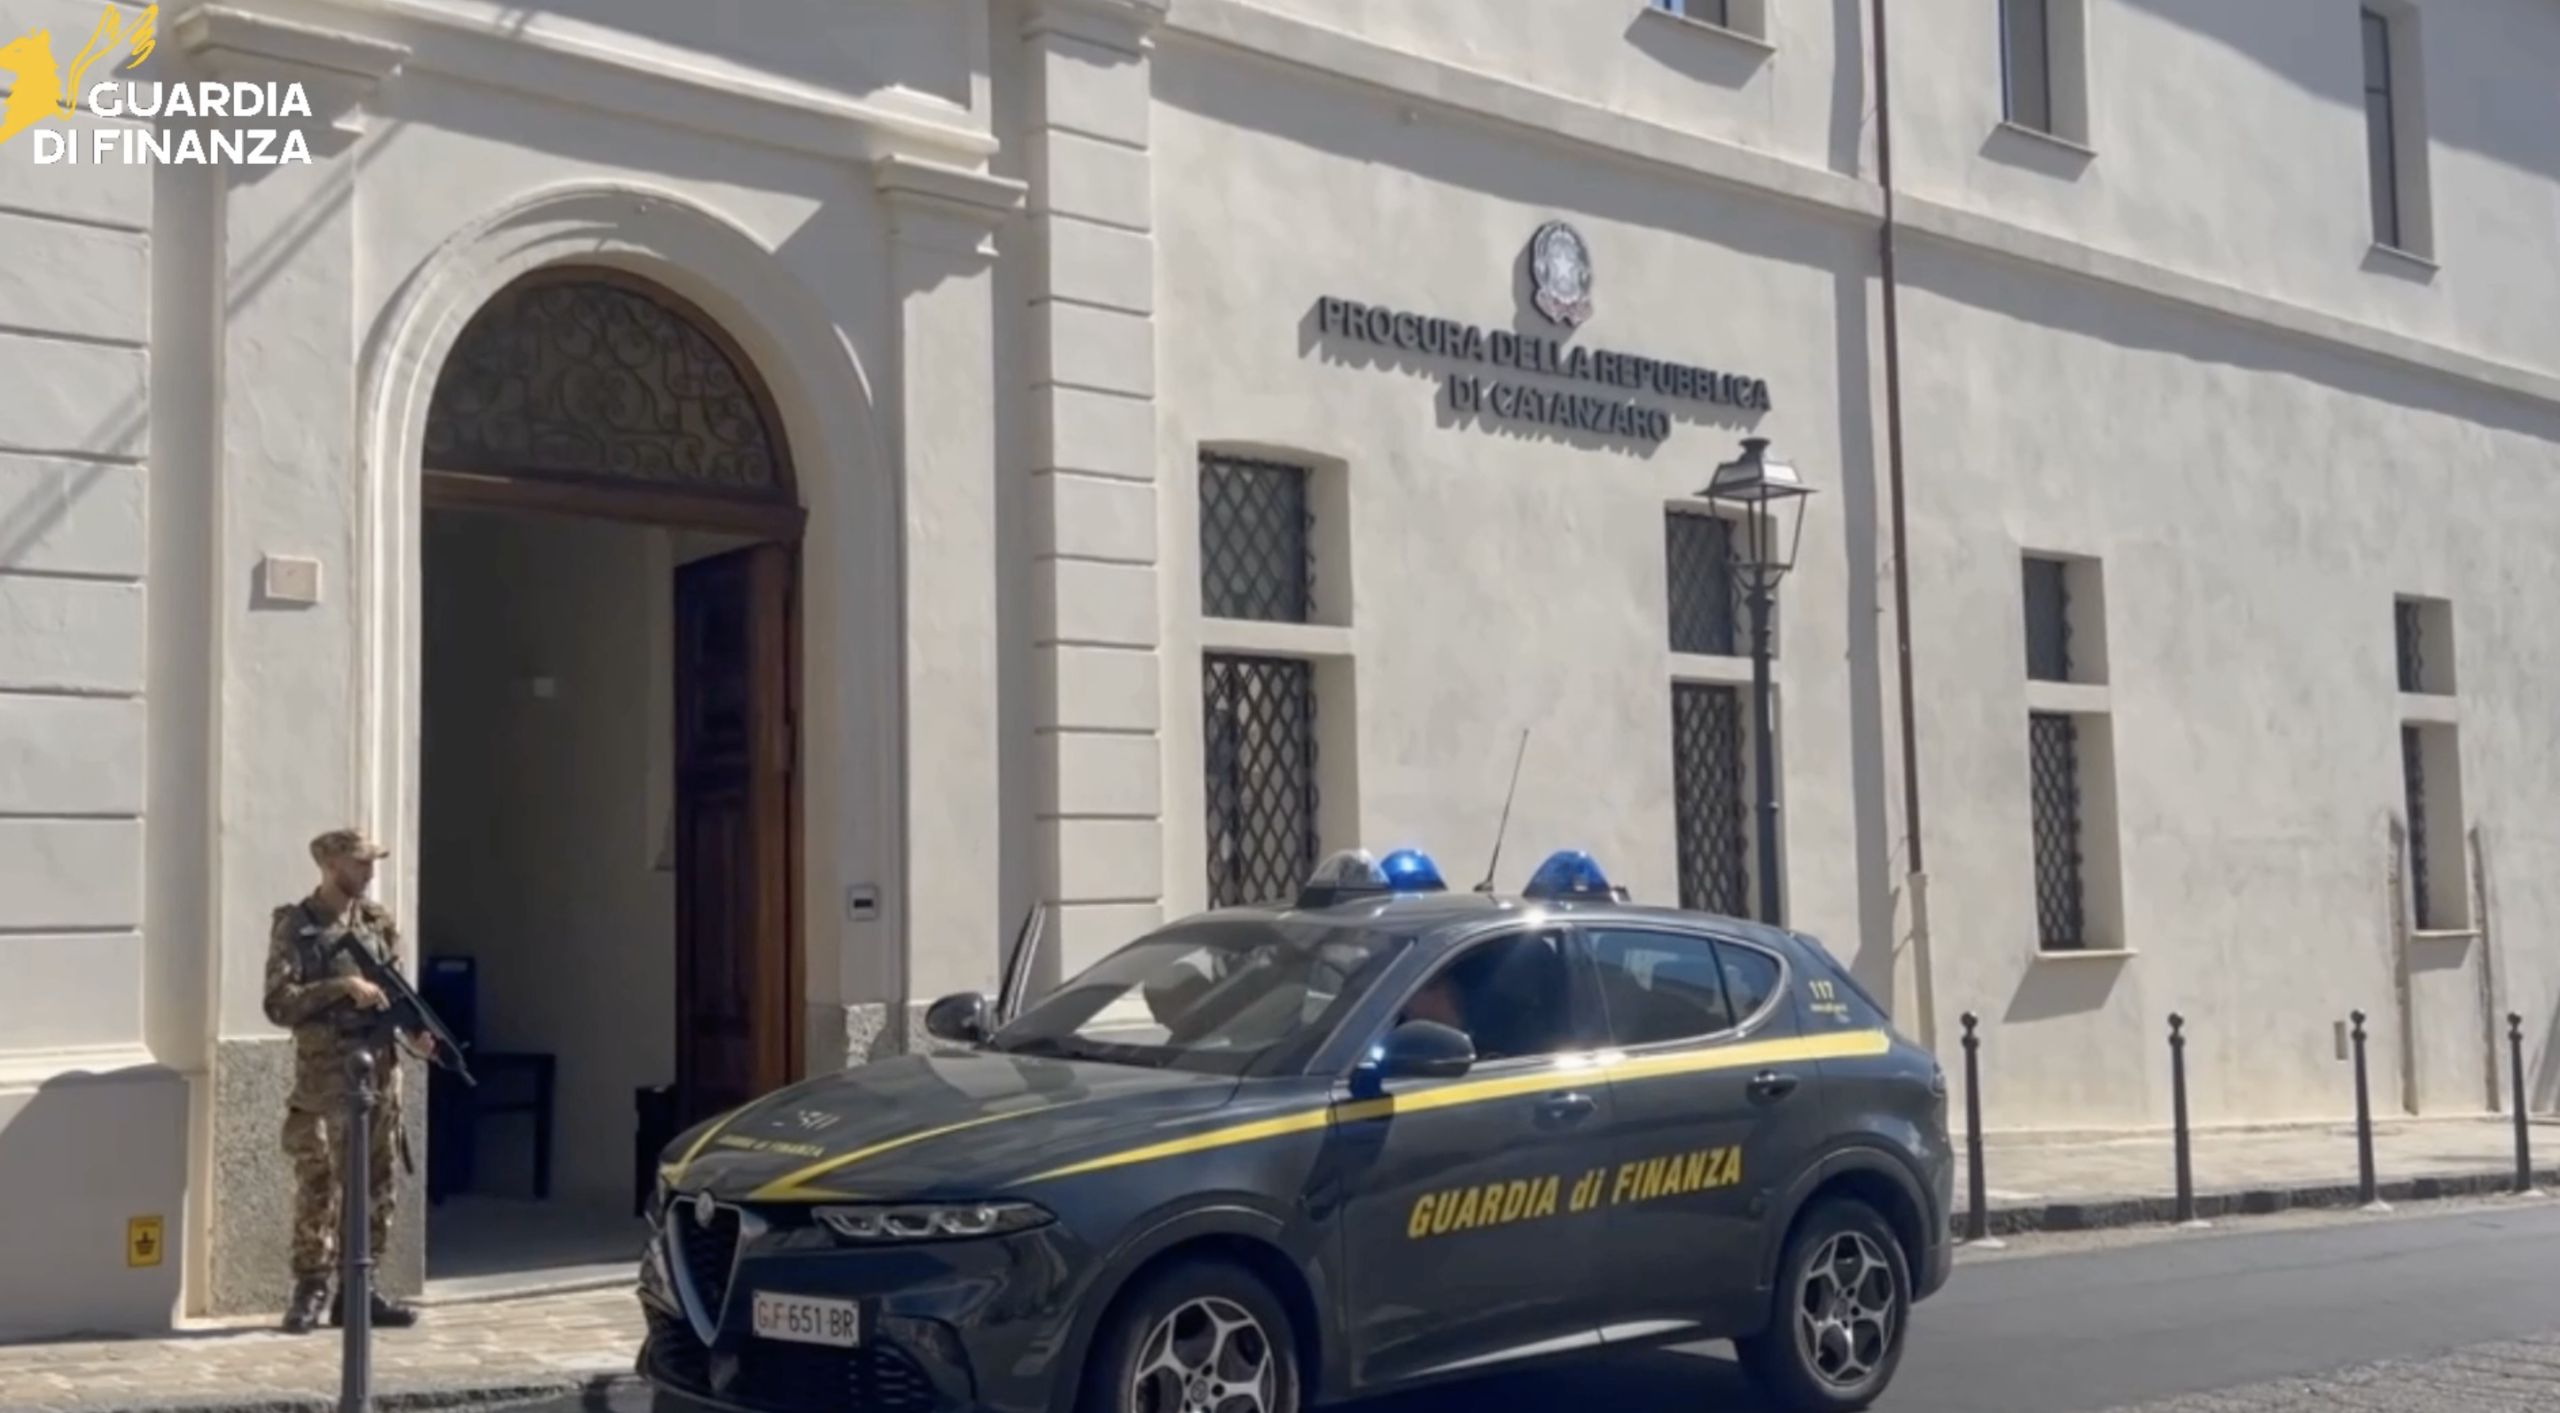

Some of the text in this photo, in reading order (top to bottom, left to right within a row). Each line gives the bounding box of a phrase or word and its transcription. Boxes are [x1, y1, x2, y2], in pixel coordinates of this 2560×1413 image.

[1318, 297, 1772, 411] PROCURA DELLA REPUBBLICA
[1448, 374, 1671, 442] DI CATANZARO
[1809, 980, 1835, 999] 117
[1407, 1144, 1742, 1239] GUARDIA di FINANZA
[788, 1304, 822, 1334] 651
[829, 1307, 855, 1338] BR
